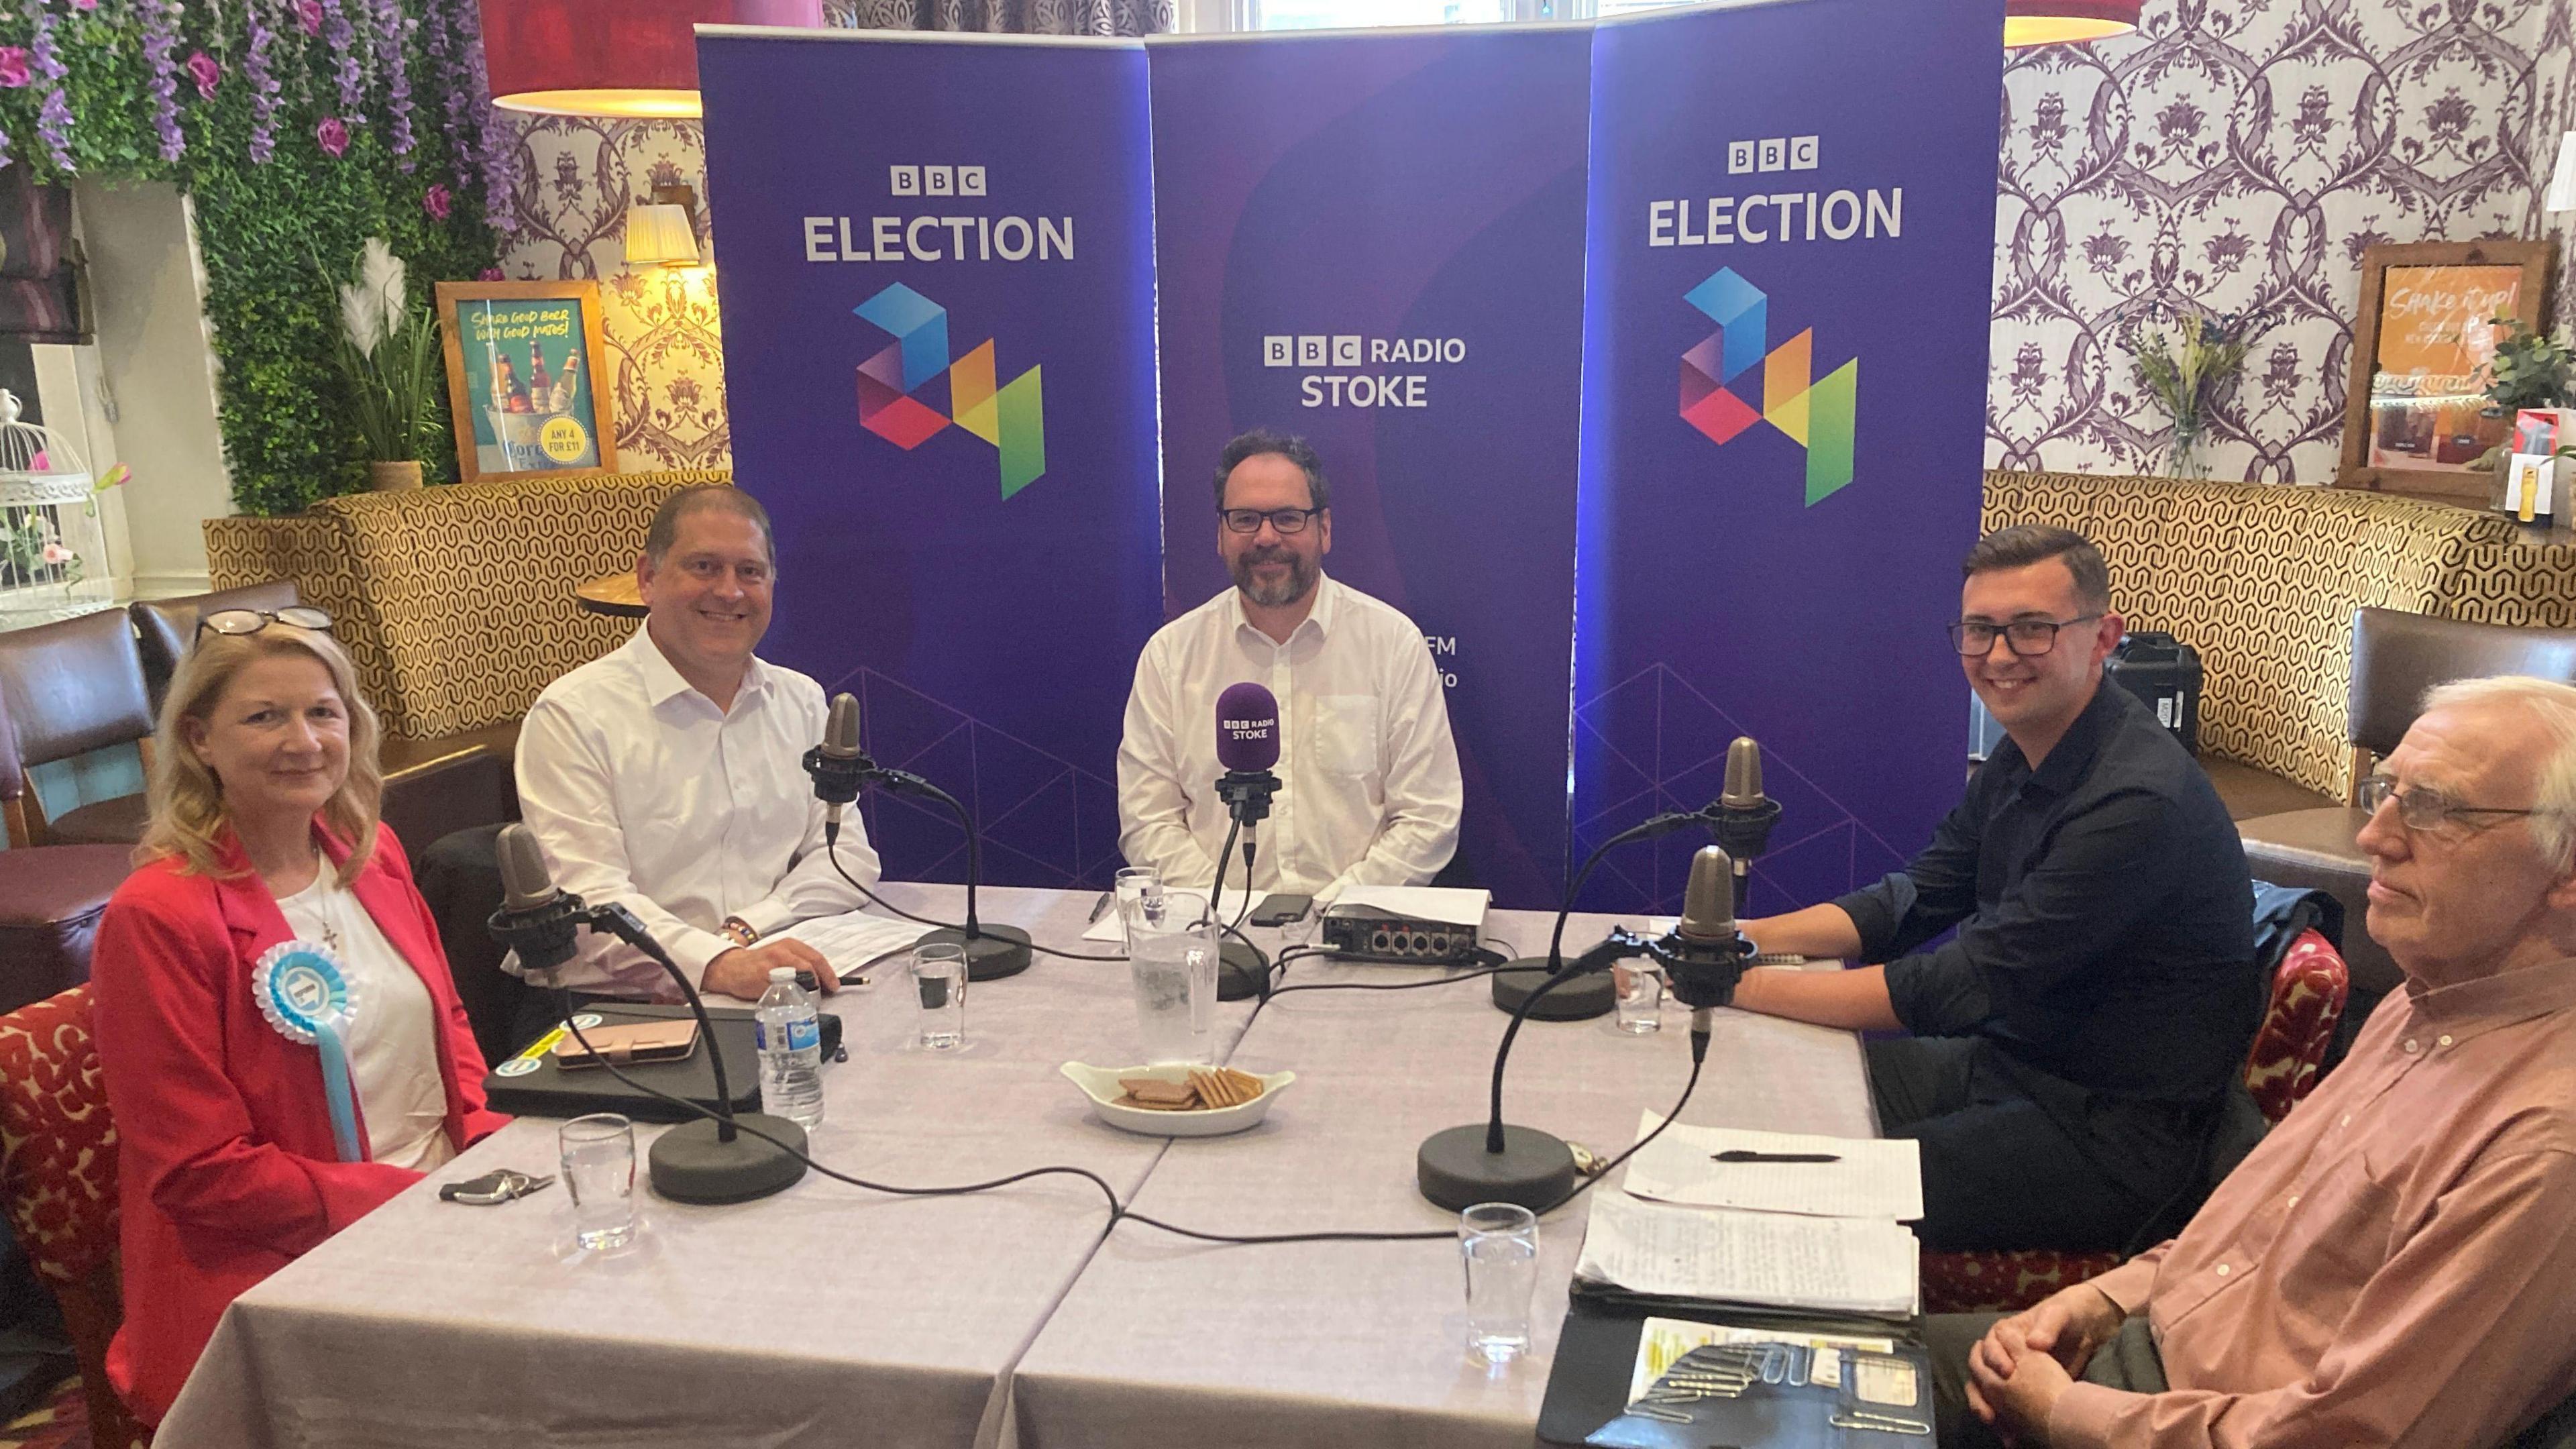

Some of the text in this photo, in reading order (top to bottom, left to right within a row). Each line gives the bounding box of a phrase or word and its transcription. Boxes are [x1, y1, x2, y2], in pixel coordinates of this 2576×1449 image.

[1728, 136, 1819, 174] BBC
[890, 165, 986, 196] BBC
[1650, 188, 1902, 246] ELECTION
[804, 216, 1074, 261] ELECTION
[1264, 335, 1466, 366] BBC RADIO
[1301, 376, 1427, 407] STOKE
[549, 441, 580, 452] FOR £11
[551, 429, 575, 439] ANY 4
[1224, 718, 1274, 730] BBC RADIO
[1233, 729, 1267, 739] STOKE
